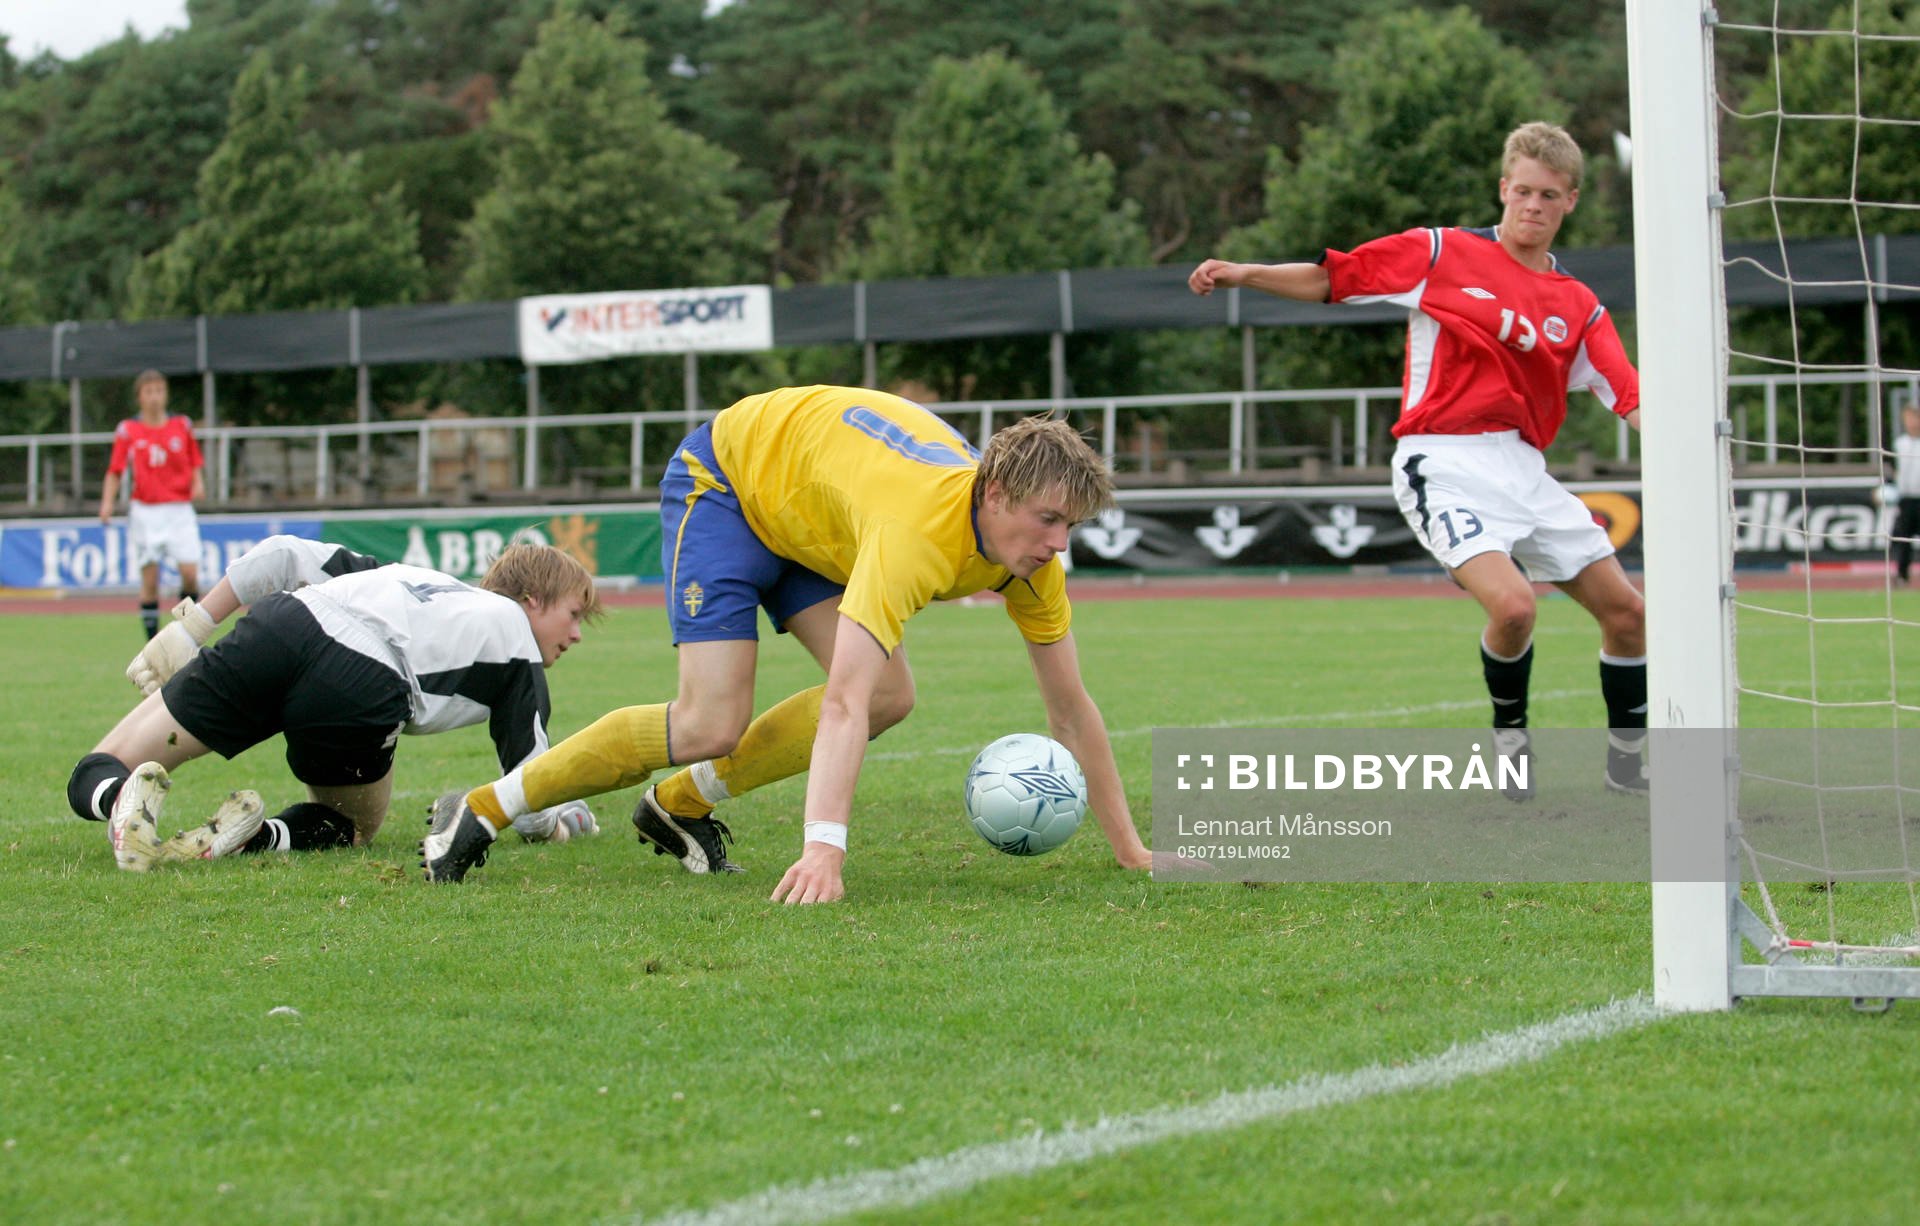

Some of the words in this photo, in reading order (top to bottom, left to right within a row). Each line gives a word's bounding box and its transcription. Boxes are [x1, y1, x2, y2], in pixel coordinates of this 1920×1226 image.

[570, 294, 747, 333] INTERSPORT
[1497, 308, 1537, 352] 13
[1438, 508, 1484, 550] 13
